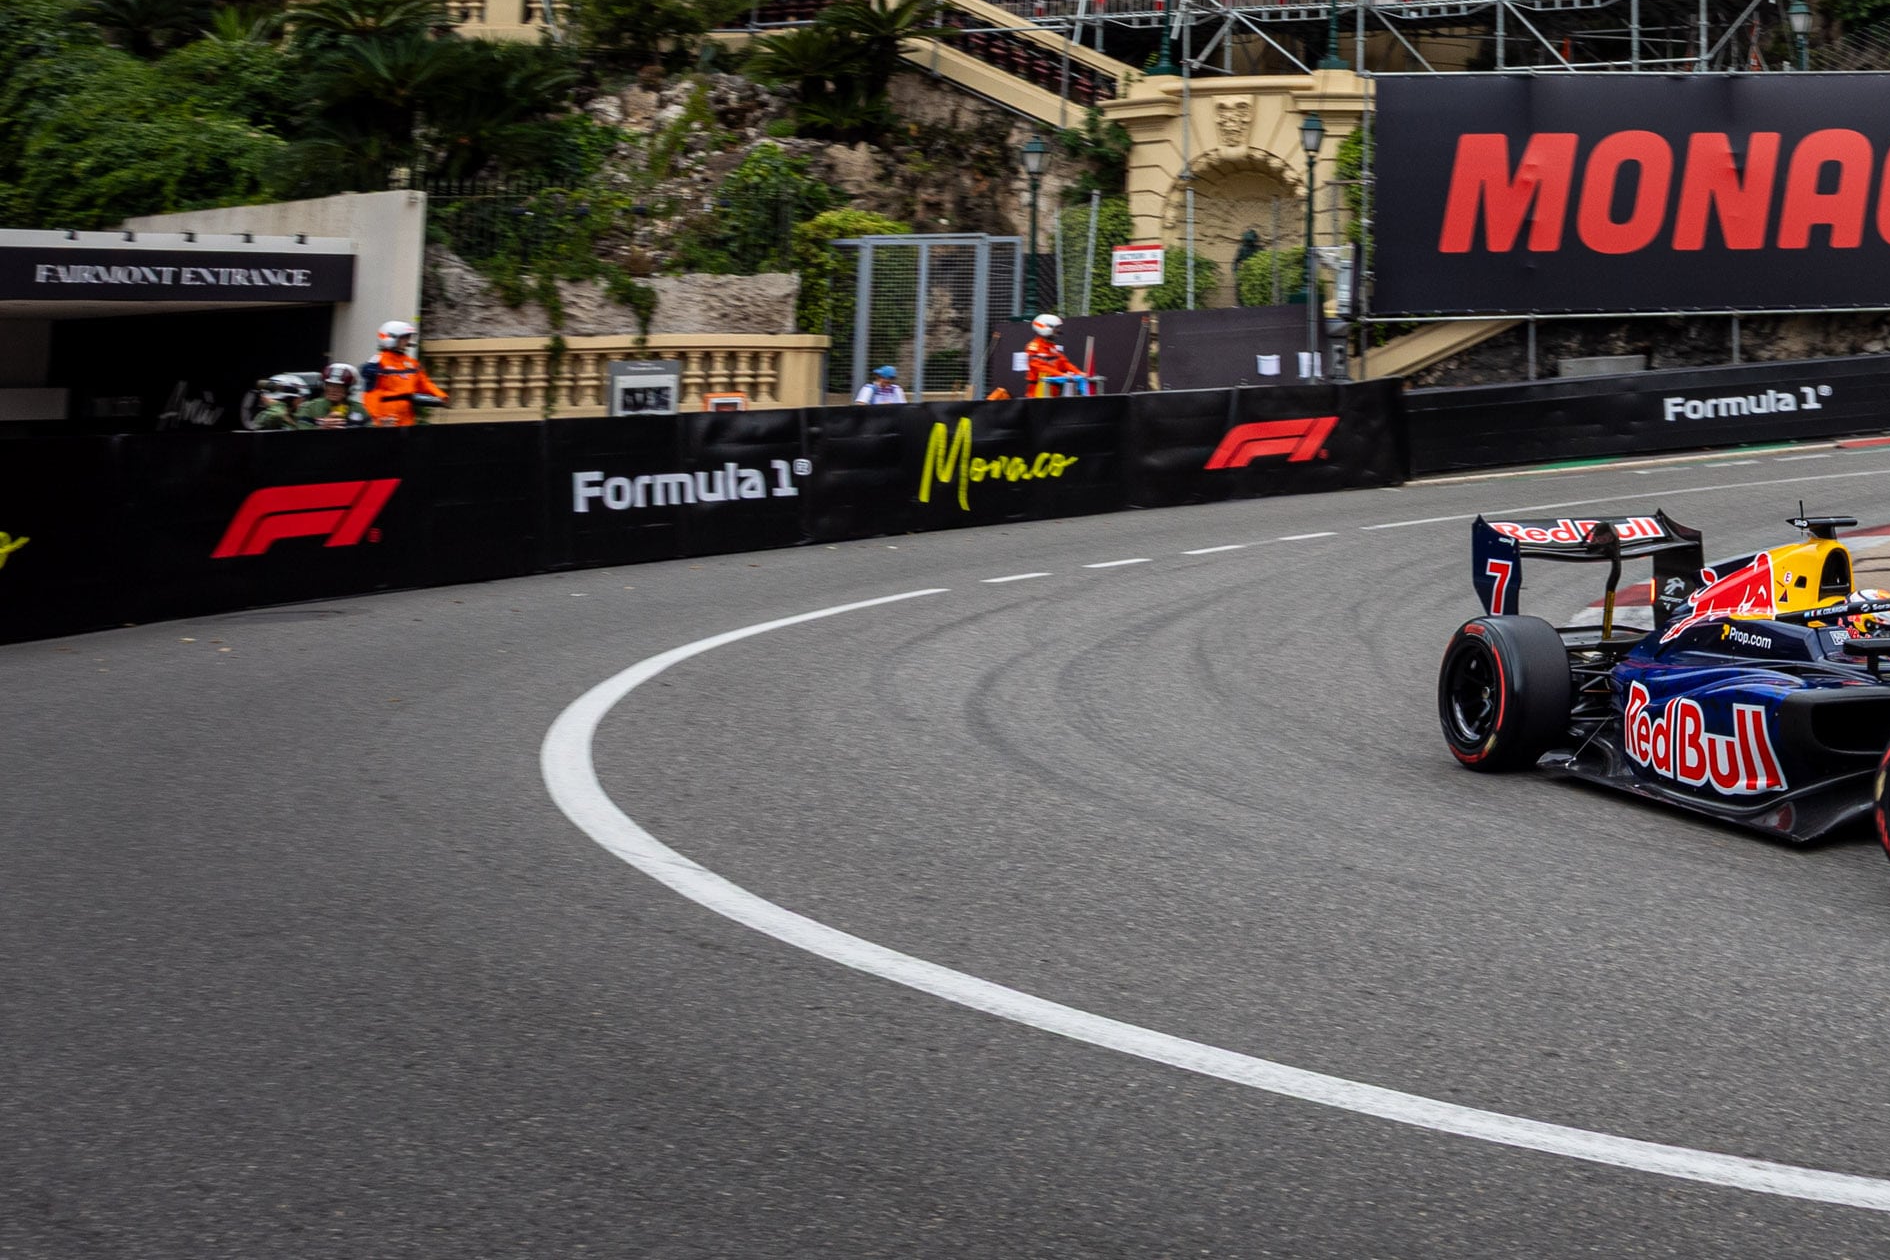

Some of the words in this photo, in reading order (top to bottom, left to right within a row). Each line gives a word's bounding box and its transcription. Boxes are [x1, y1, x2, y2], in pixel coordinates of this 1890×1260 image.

[35, 263, 175, 287] FAIRMONT
[180, 266, 312, 288] ENTRANCE
[1663, 389, 1798, 422] Formula
[919, 417, 1079, 511] Monaco
[572, 462, 766, 513] Formula
[1486, 558, 1513, 616] 7
[1729, 626, 1772, 649] Prop.com
